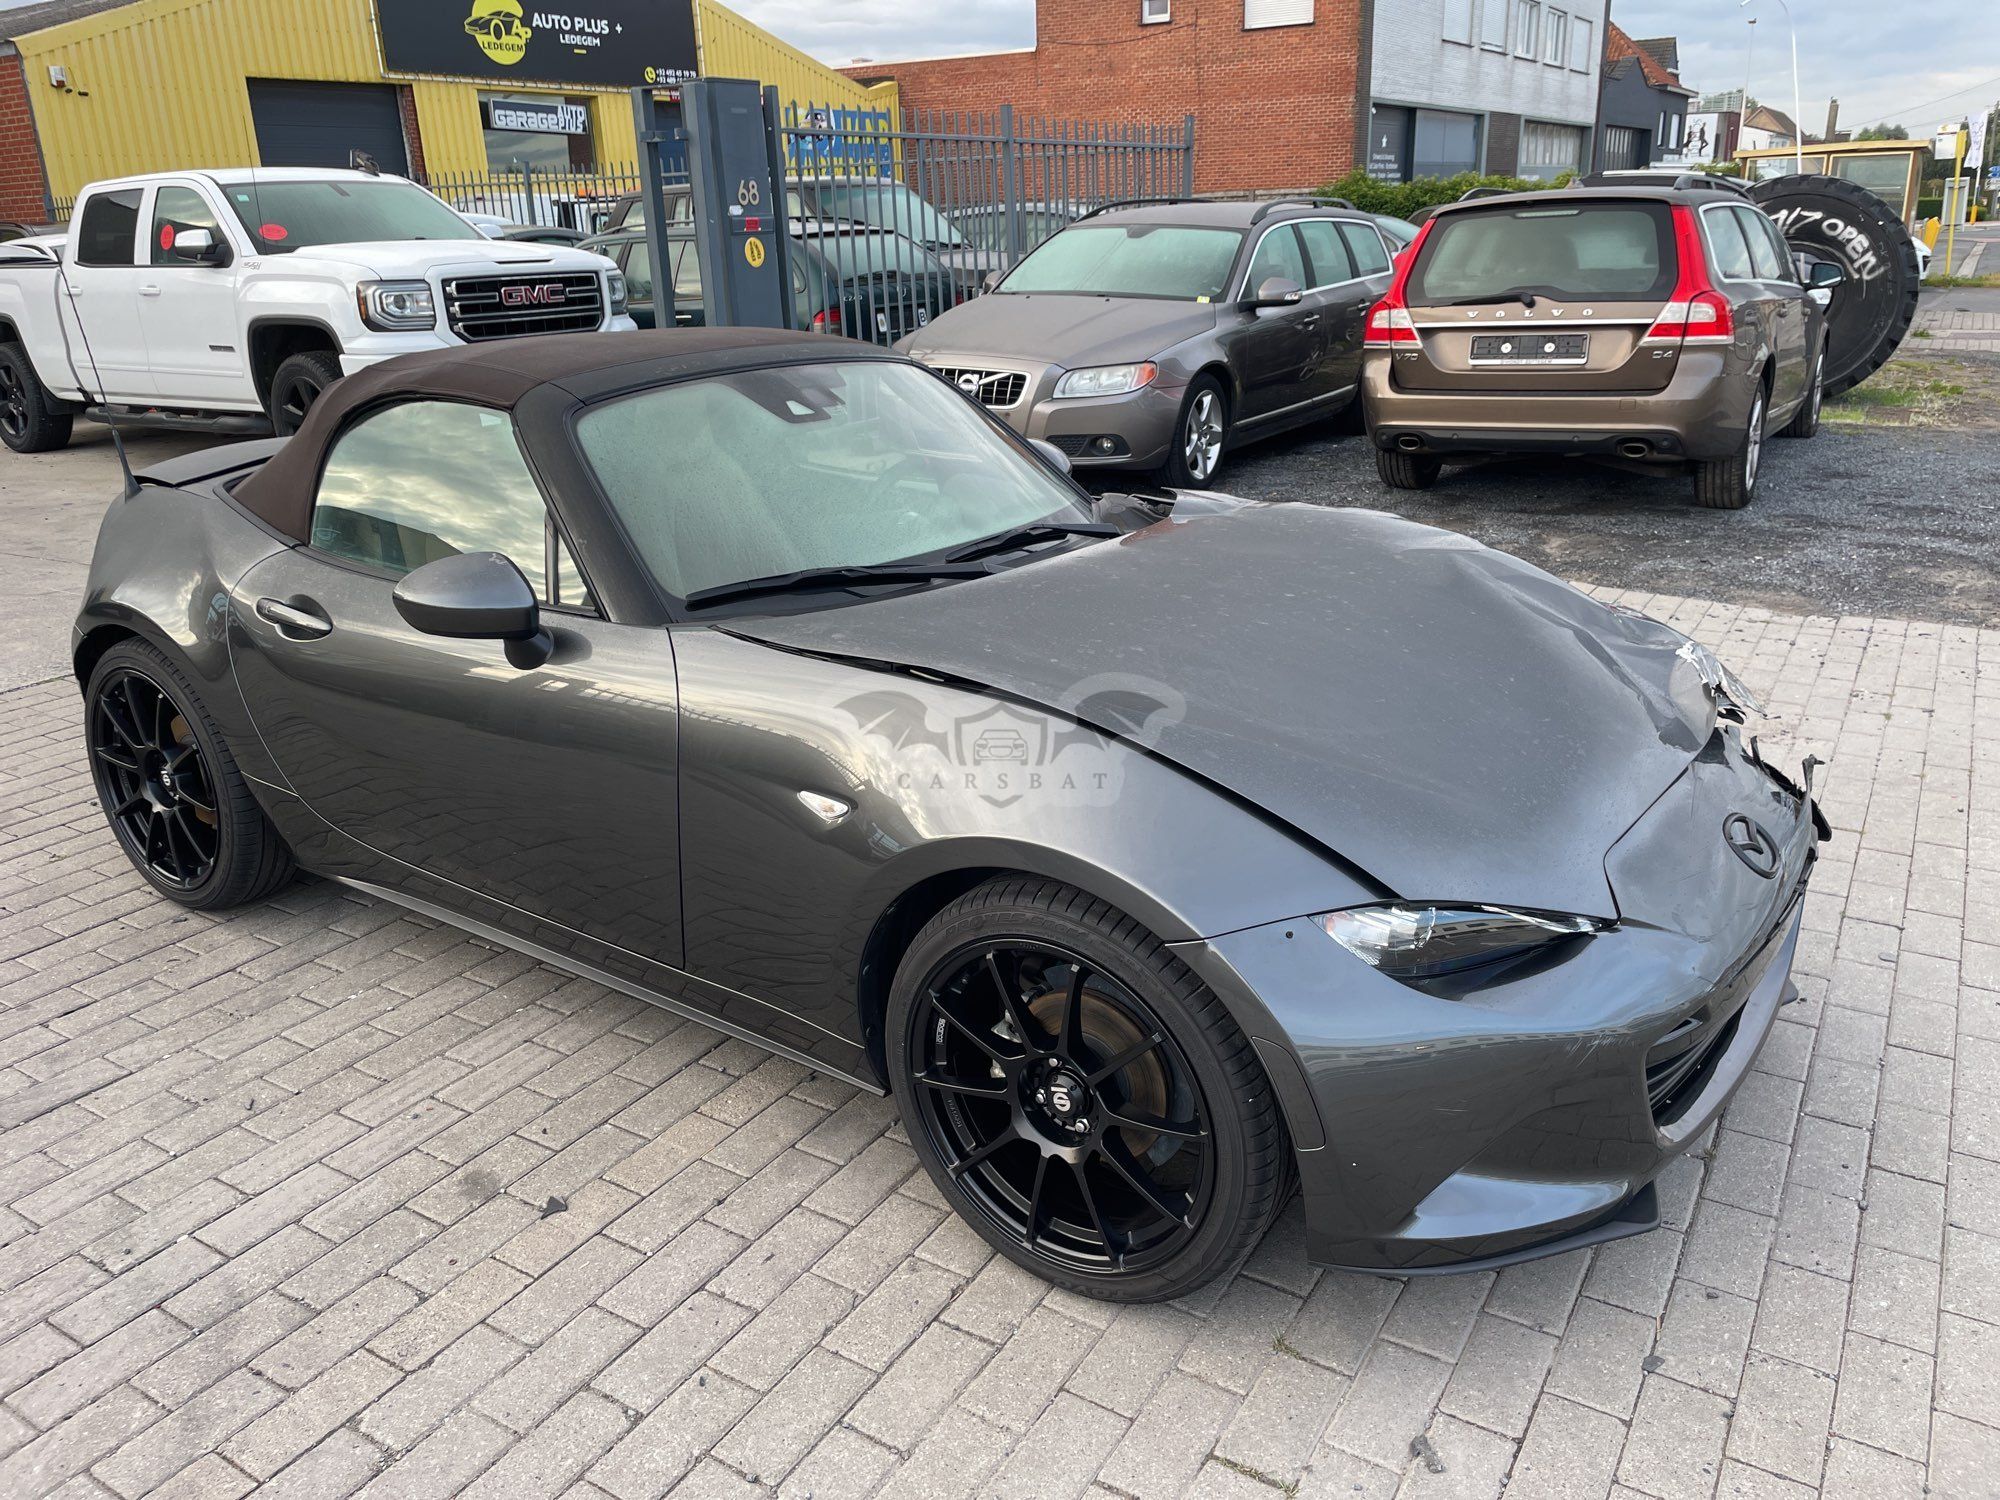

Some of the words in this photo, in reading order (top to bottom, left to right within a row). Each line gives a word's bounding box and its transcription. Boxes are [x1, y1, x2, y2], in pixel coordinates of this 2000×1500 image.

[532, 12, 571, 31] AUTO
[574, 17, 610, 34] PLUS
[482, 41, 524, 52] LEDEGEM
[559, 33, 601, 47] LEDEGEM
[557, 105, 585, 120] AUTO
[558, 118, 583, 132] PLUS
[738, 179, 760, 206] 68
[1821, 218, 1888, 281] OPEN
[501, 283, 566, 306] GMC
[1466, 308, 1594, 319] VOLVO
[1395, 352, 1419, 361] V70
